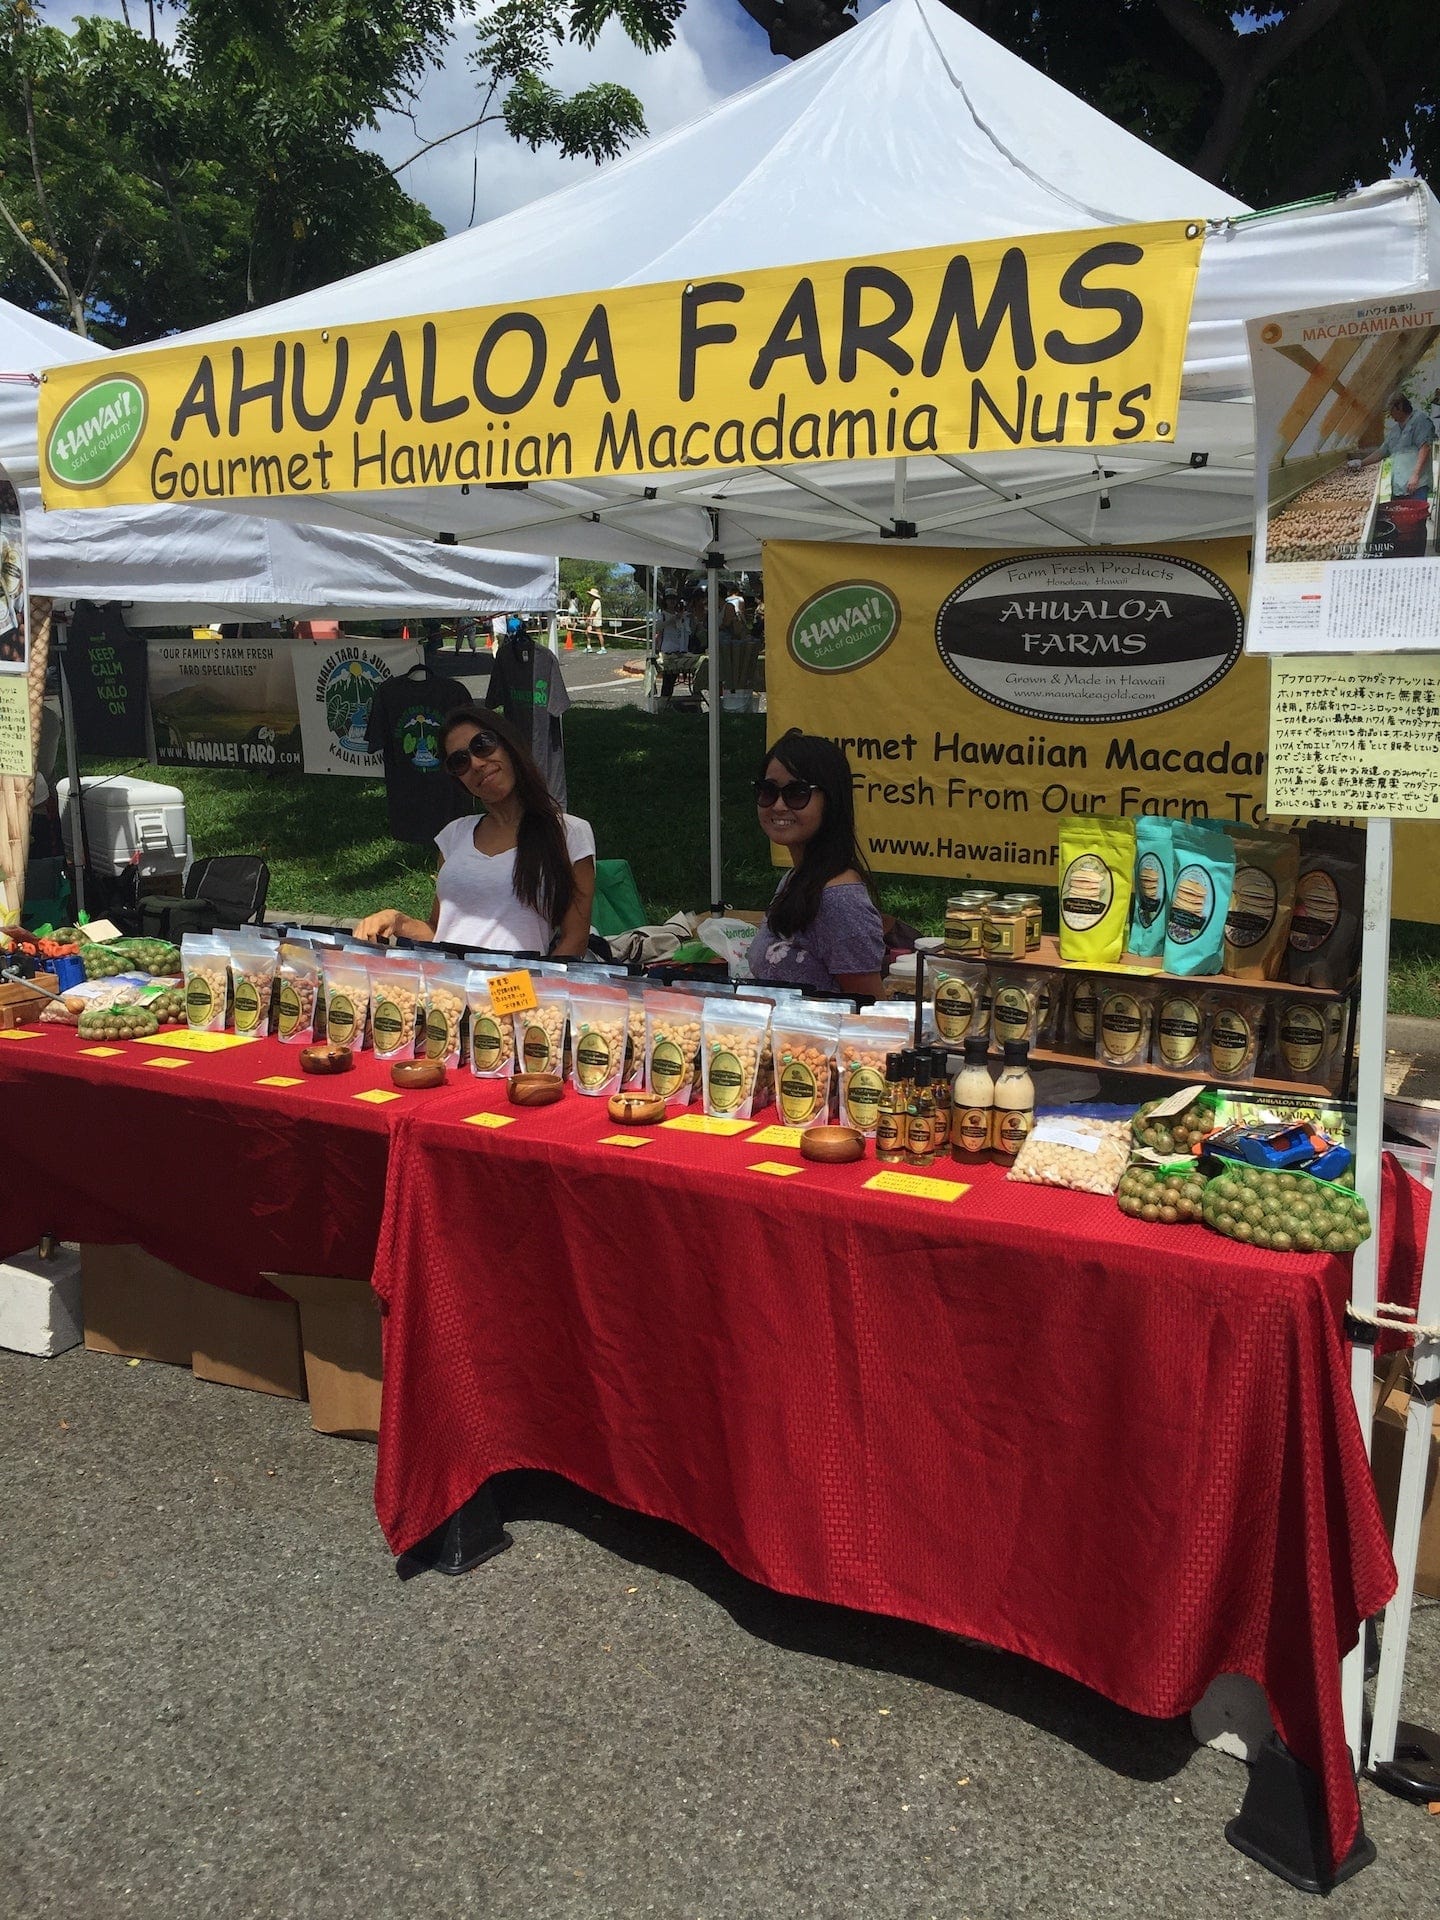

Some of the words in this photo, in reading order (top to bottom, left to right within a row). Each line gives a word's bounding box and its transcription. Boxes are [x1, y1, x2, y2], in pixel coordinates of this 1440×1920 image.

[1303, 316, 1400, 341] MACADAMIA
[1402, 312, 1434, 328] NUT
[170, 304, 621, 441] AHUALOA
[679, 241, 1144, 402] FARMS
[71, 453, 89, 471] SEAL
[90, 446, 98, 457] of
[98, 421, 131, 450] QUALITY
[151, 440, 331, 500] Gourmet
[353, 422, 572, 487] Hawaiian
[595, 388, 939, 470] Macadamia
[969, 376, 1151, 449] Nuts
[1007, 567, 1047, 583] Farm
[1051, 561, 1095, 575] Fresh
[1101, 561, 1175, 581] Products
[1096, 578, 1128, 586] Hawaii
[999, 598, 1174, 622] AHUALOA
[814, 644, 834, 658] SEAL
[835, 639, 843, 649] of
[845, 623, 882, 645] QUALITY
[1022, 633, 1147, 655] FARMS
[88, 647, 115, 661] KEEP
[182, 648, 219, 659] FAMILY'S
[222, 649, 244, 659] FARM
[247, 649, 273, 659] FRESH
[92, 662, 123, 676] CALM
[179, 665, 199, 676] TARO
[316, 656, 337, 702] HANALEI
[335, 647, 359, 660] TARO
[362, 650, 368, 662] &
[370, 655, 391, 679] JUIC
[1005, 672, 1047, 685] Grown
[1050, 673, 1061, 685] &
[1063, 673, 1101, 686] Made
[1105, 676, 1116, 685] in
[1119, 675, 1165, 686] Hawaii
[97, 685, 128, 700] KALO
[1013, 689, 1156, 702] www.maunakeagold.com
[109, 702, 126, 715] ON
[329, 743, 360, 766] KAUAI
[800, 732, 917, 761] urmet
[934, 731, 1087, 769] Hawaiian
[850, 773, 934, 806] Fresh
[948, 778, 1029, 812] From
[1042, 784, 1106, 815] Our
[1121, 787, 1209, 819] Farm
[1257, 1098, 1295, 1106] AHUALOA
